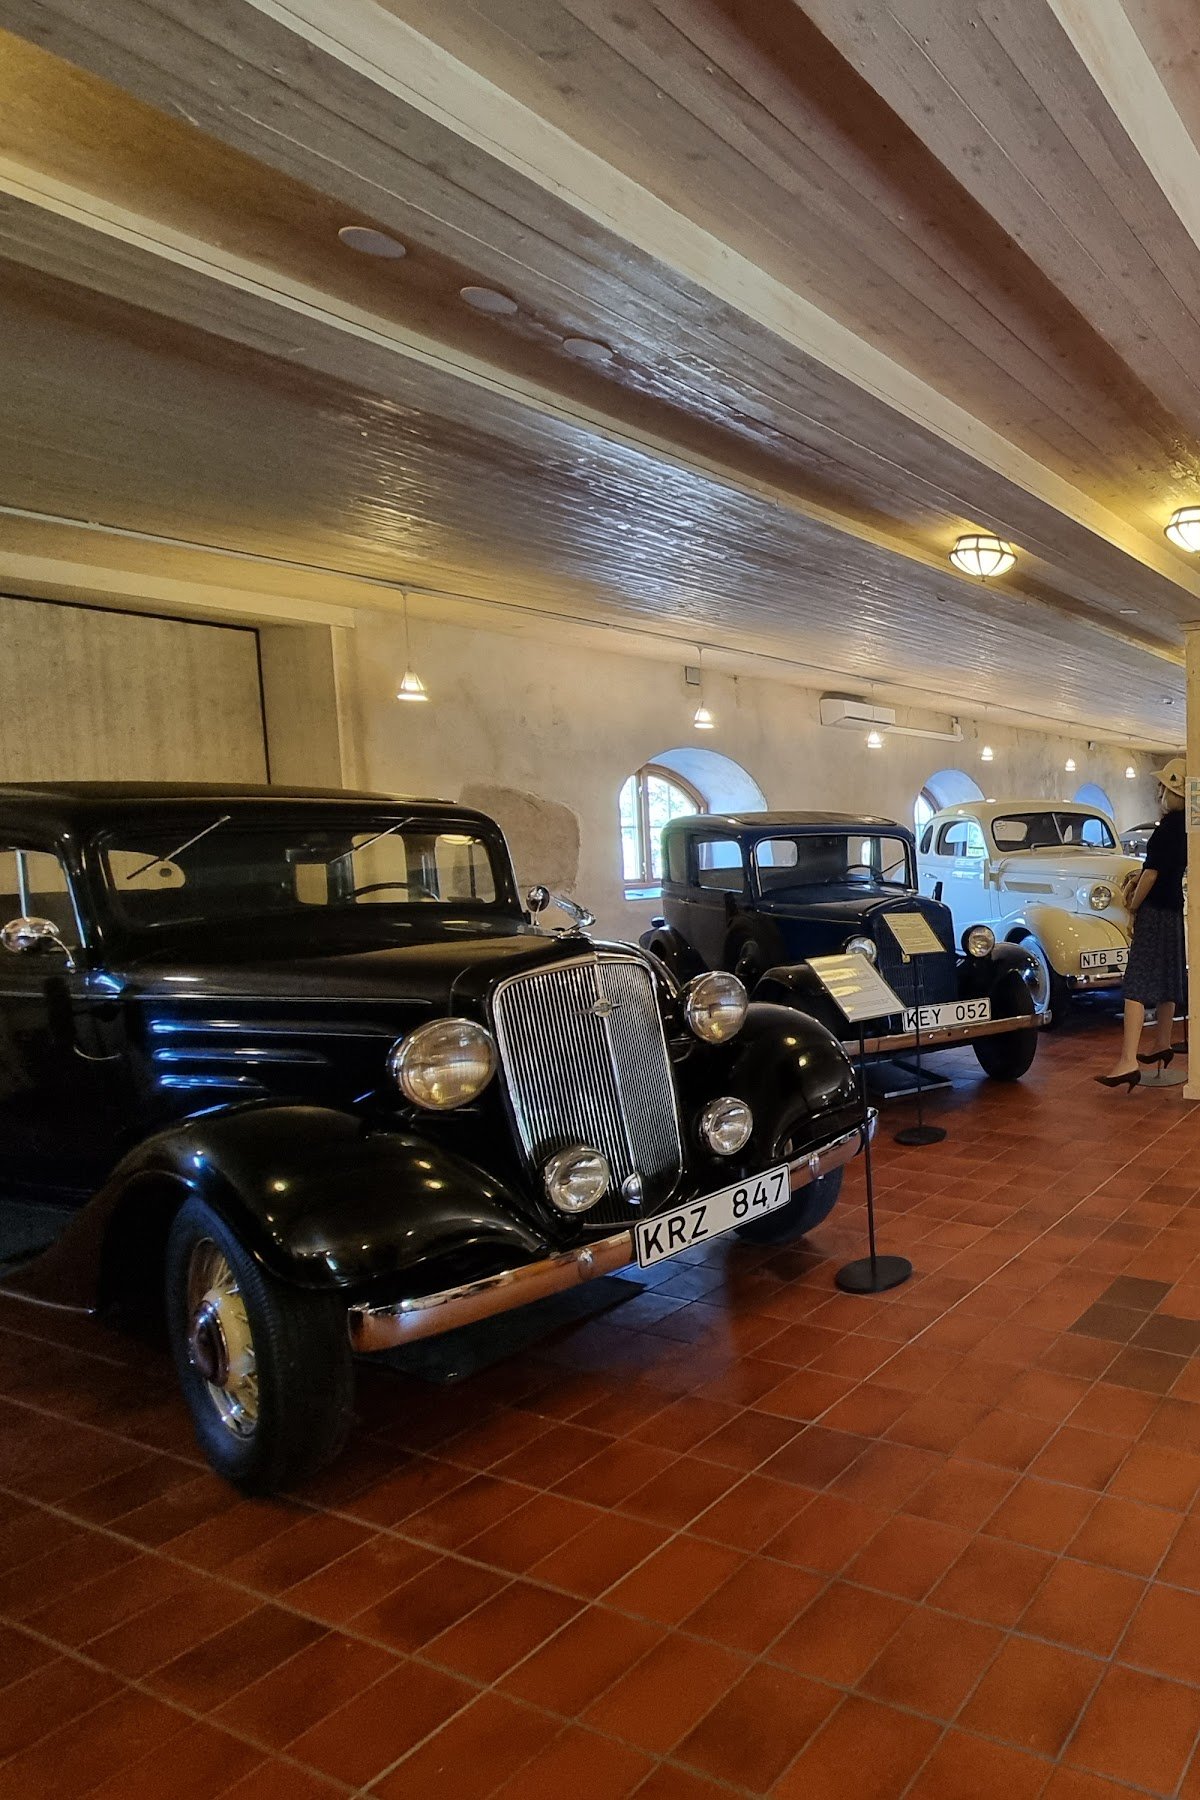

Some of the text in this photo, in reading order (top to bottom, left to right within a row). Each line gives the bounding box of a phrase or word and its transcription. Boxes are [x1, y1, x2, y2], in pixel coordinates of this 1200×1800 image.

[1082, 952, 1107, 967] NTB
[907, 1002, 988, 1029] KEY 052
[643, 1172, 784, 1260] KRZ 847
